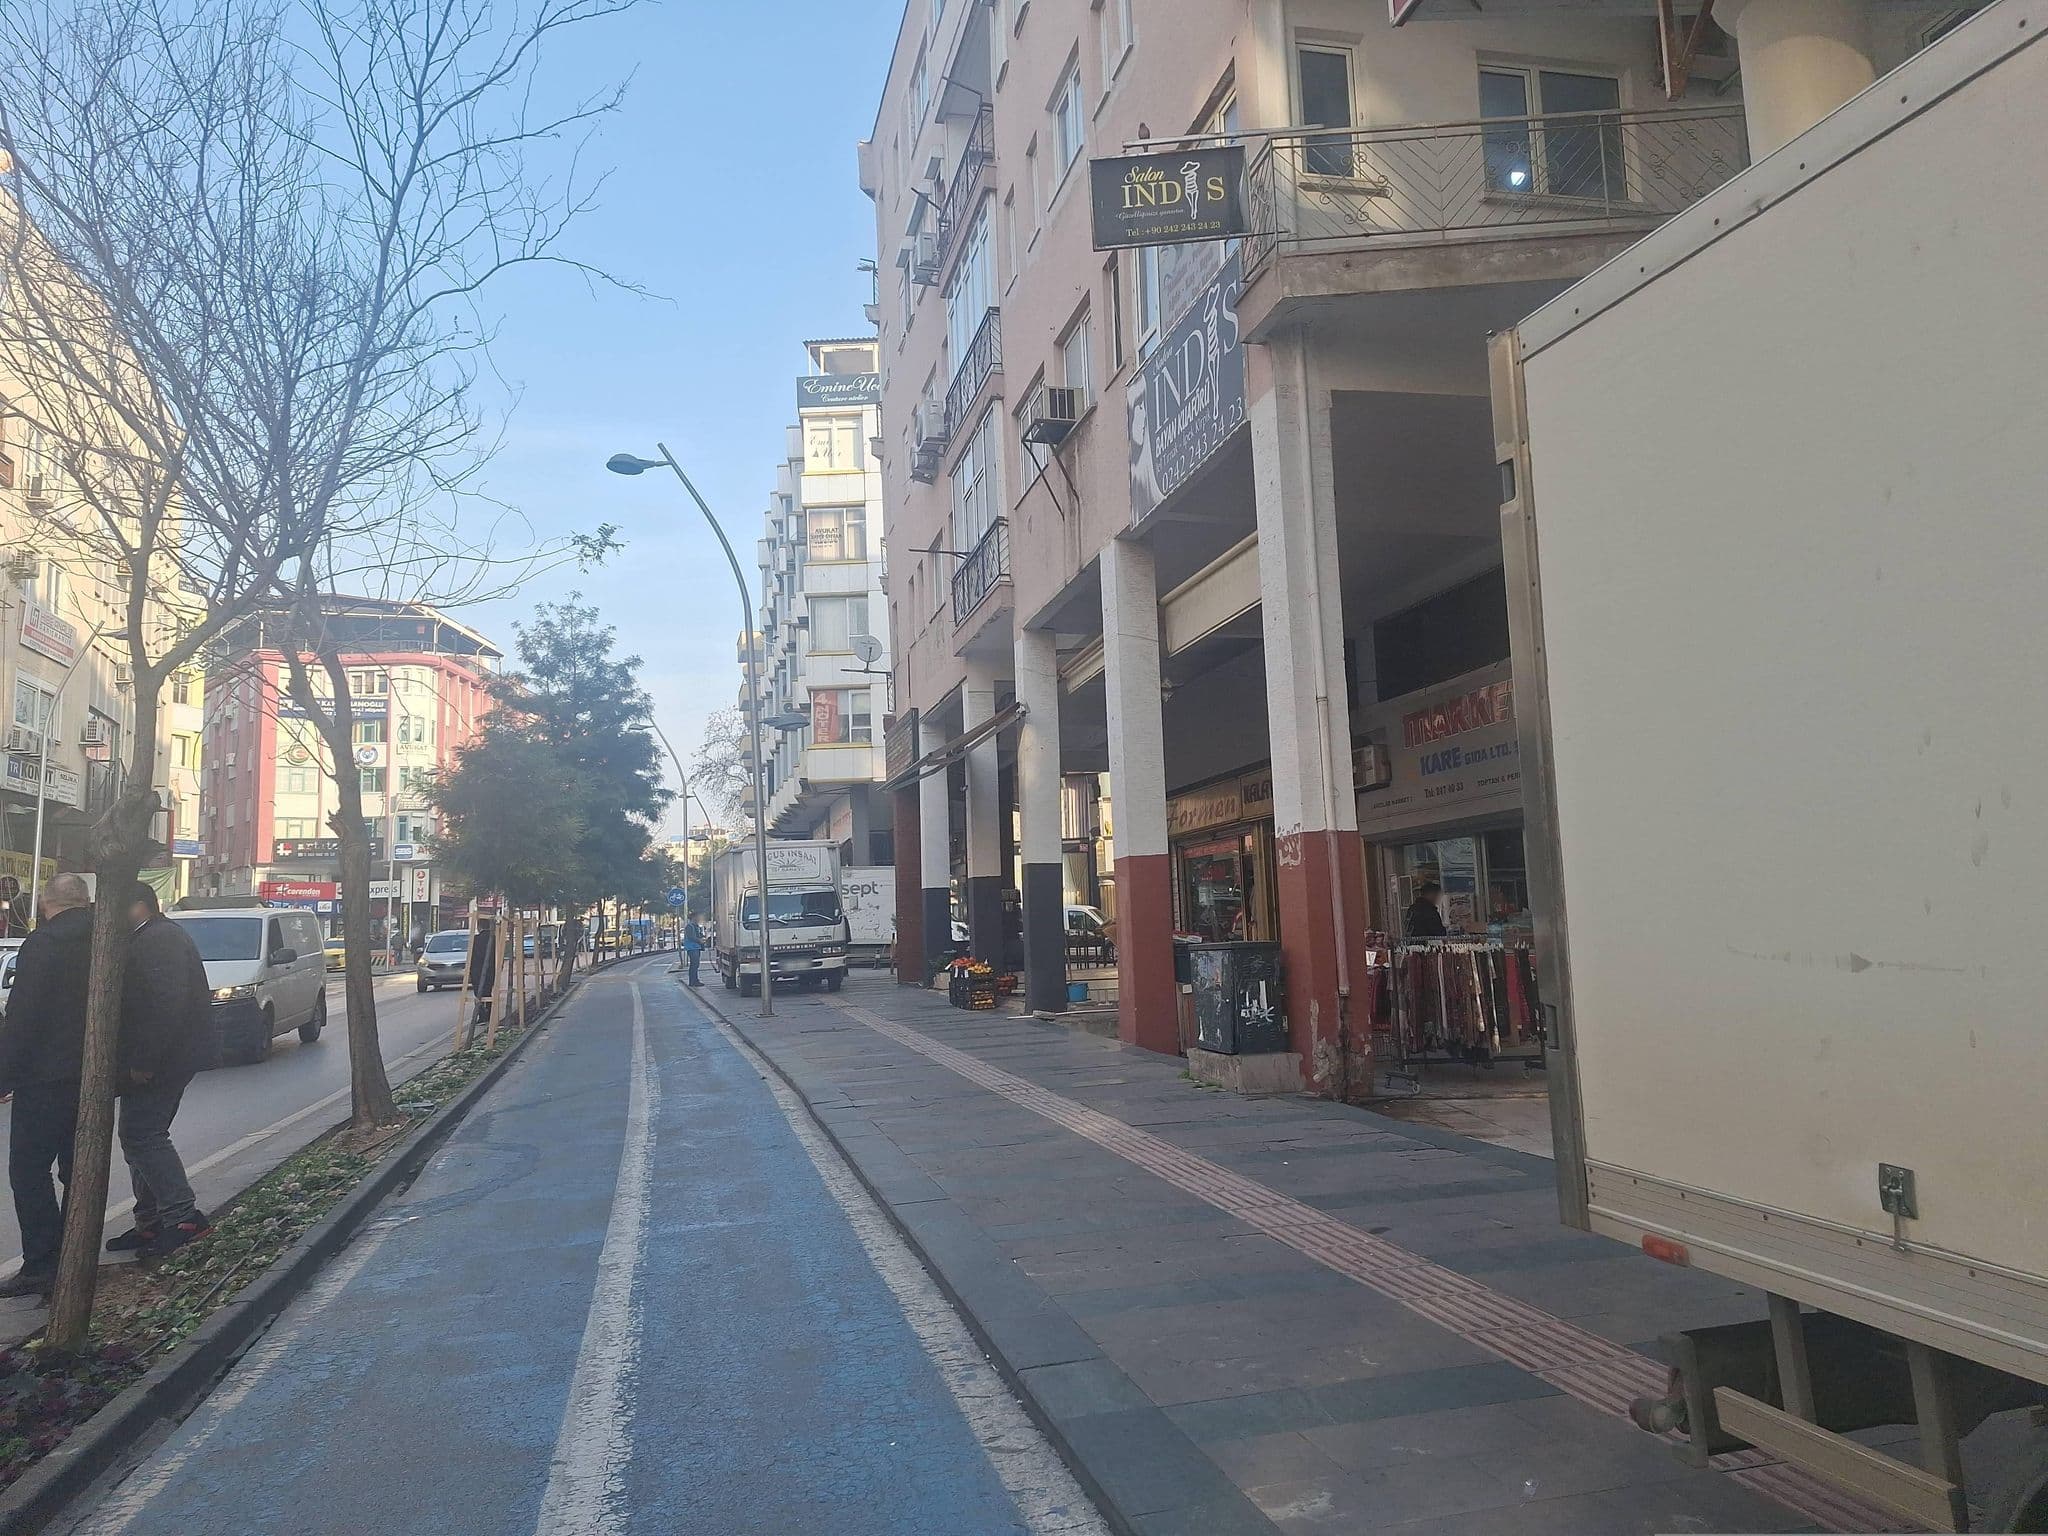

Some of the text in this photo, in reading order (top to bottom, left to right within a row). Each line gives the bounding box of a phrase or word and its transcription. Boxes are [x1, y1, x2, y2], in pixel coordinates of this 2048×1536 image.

[1125, 166, 1164, 184] Salon
[1163, 223, 1179, 233] 242
[1181, 222, 1196, 232] 243
[1198, 221, 1208, 231] 24
[1210, 220, 1221, 230] 23
[803, 379, 853, 394] Emine
[1156, 417, 1177, 458] BAYAN
[1162, 396, 1243, 493] 0242 243 24 23
[1403, 679, 1514, 750] MARKE
[1420, 746, 1462, 777] KARE
[9, 760, 54, 785] TR KONT
[369, 885, 398, 895] xpres
[773, 943, 816, 951] MITSUBISHI
